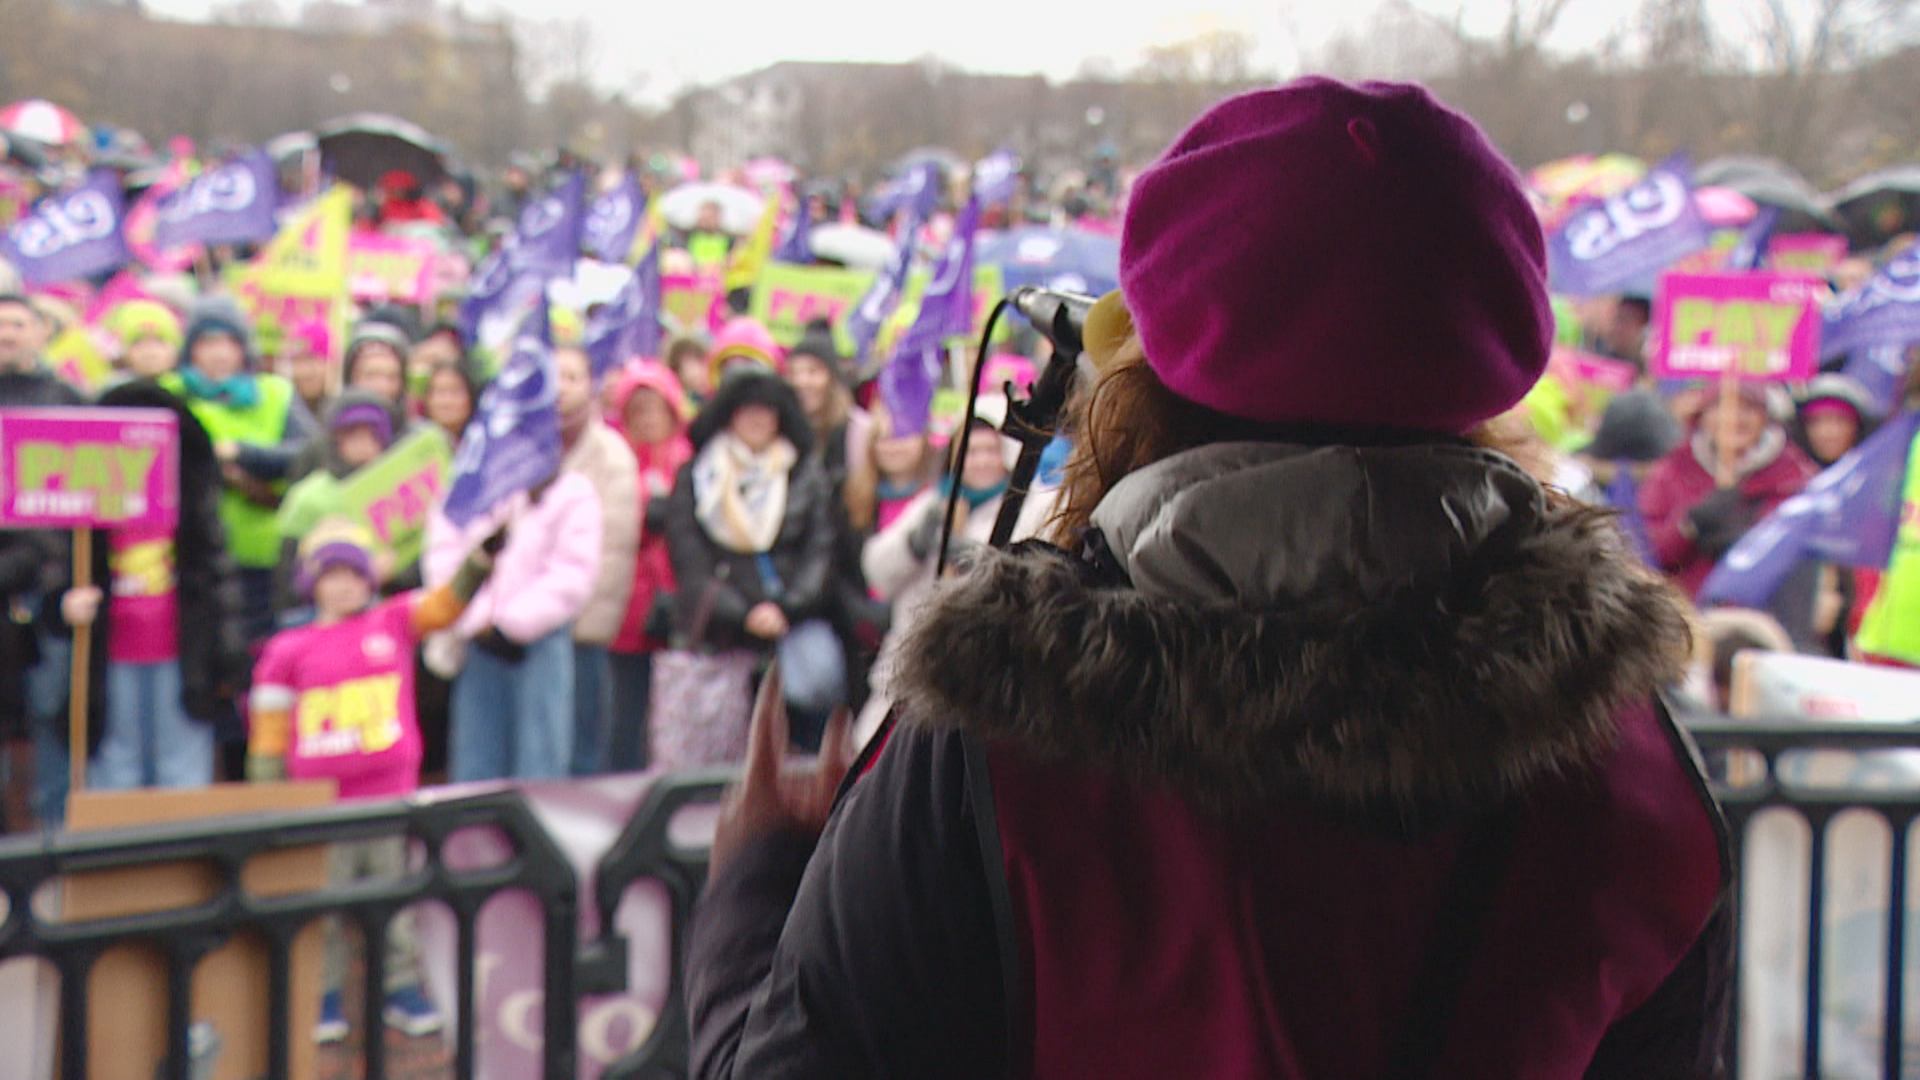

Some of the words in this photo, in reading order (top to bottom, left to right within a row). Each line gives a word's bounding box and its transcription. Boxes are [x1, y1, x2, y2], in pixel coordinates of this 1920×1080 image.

[1674, 300, 1797, 346] PAY
[19, 443, 152, 490] PAY
[298, 673, 403, 735] PAY
